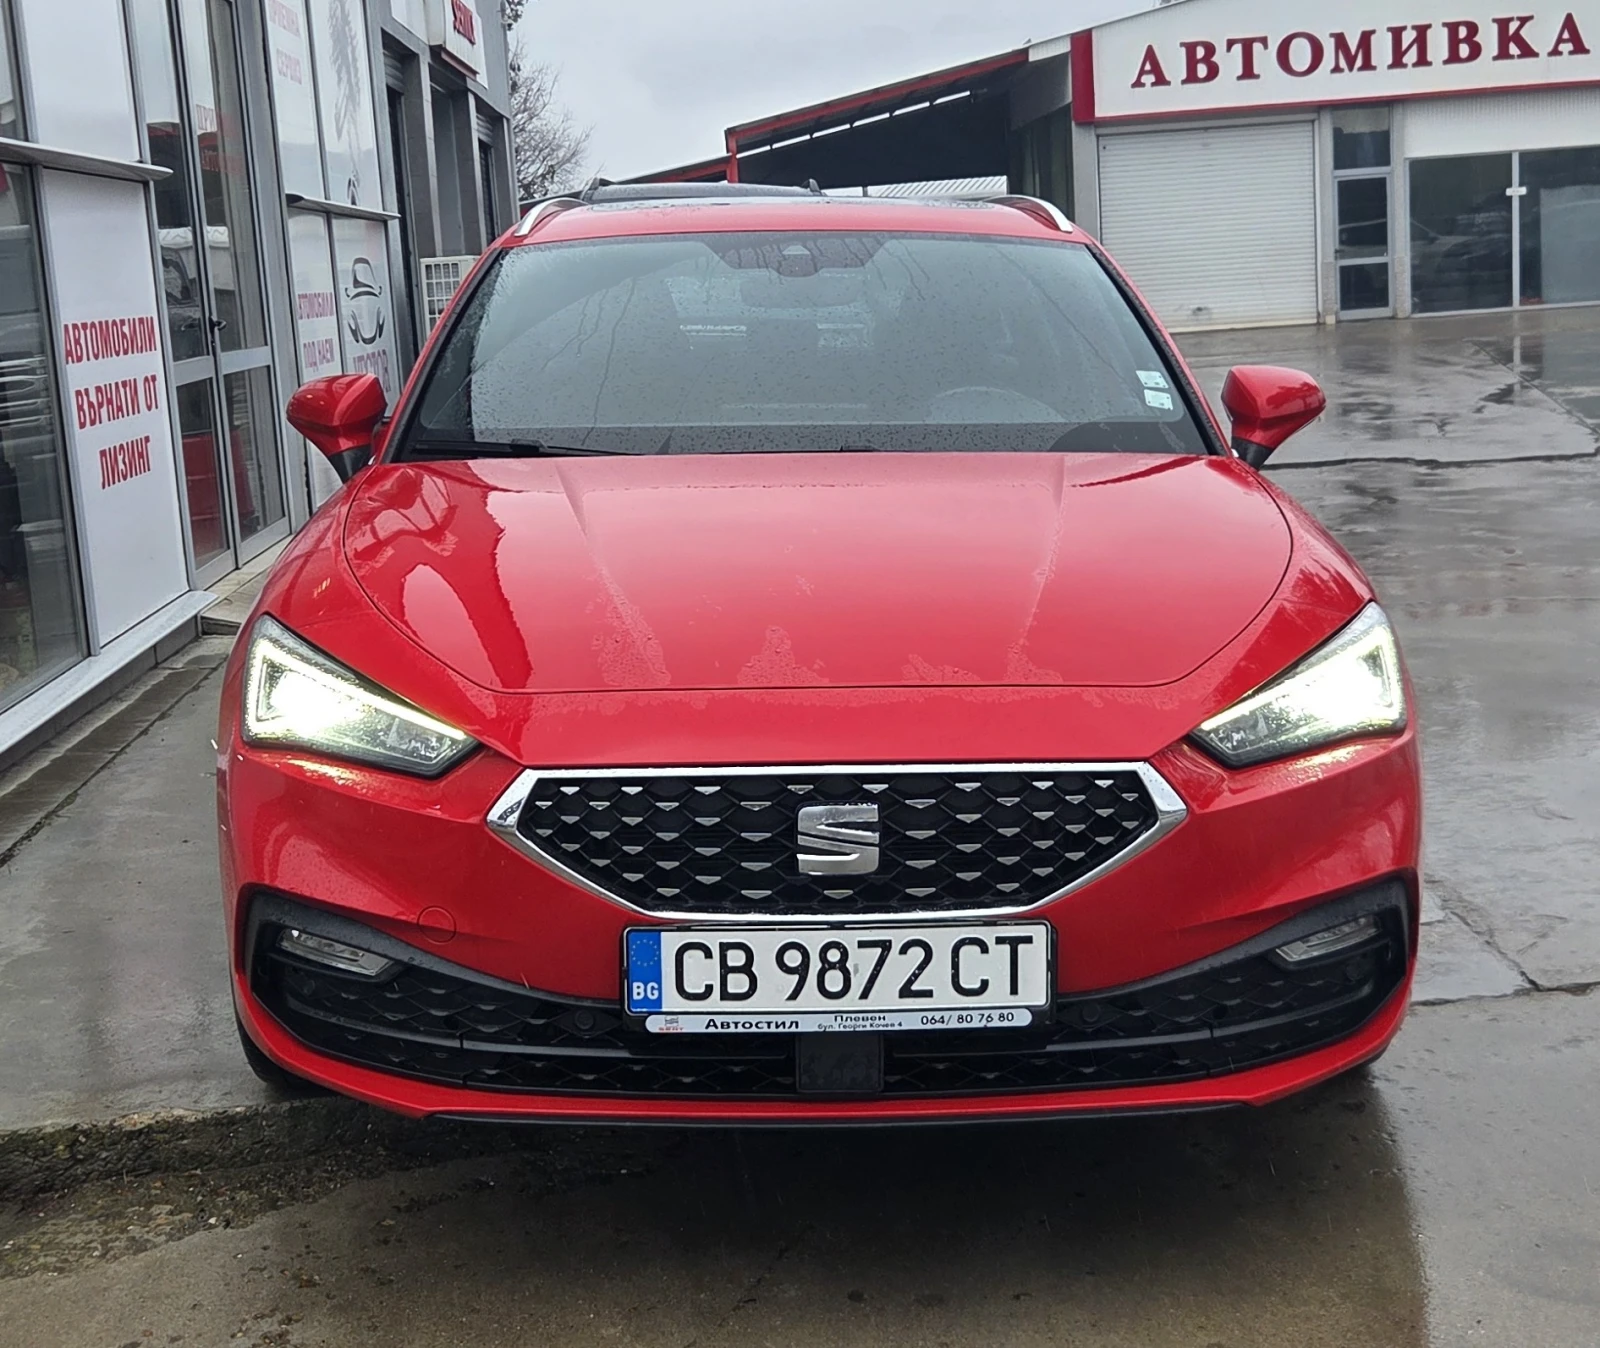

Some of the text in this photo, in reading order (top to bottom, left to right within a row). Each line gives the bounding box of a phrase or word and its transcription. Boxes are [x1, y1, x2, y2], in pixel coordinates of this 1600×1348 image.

[1130, 12, 1591, 89] АВТОМИВКА
[63, 316, 157, 365] АВТОМОБИЛИ
[75, 374, 158, 430] ВЪРНАТИ ОТ
[99, 435, 151, 490] ЛИЗИНГ
[674, 935, 1034, 1001] CB 9872 CT
[632, 981, 659, 1000] BG
[705, 1018, 799, 1030] Автостил
[834, 1014, 886, 1022] Плевен
[838, 1022, 867, 1032] Георги
[957, 1013, 973, 1024] 80
[977, 1013, 994, 1024] 76
[997, 1012, 1015, 1022] 80
